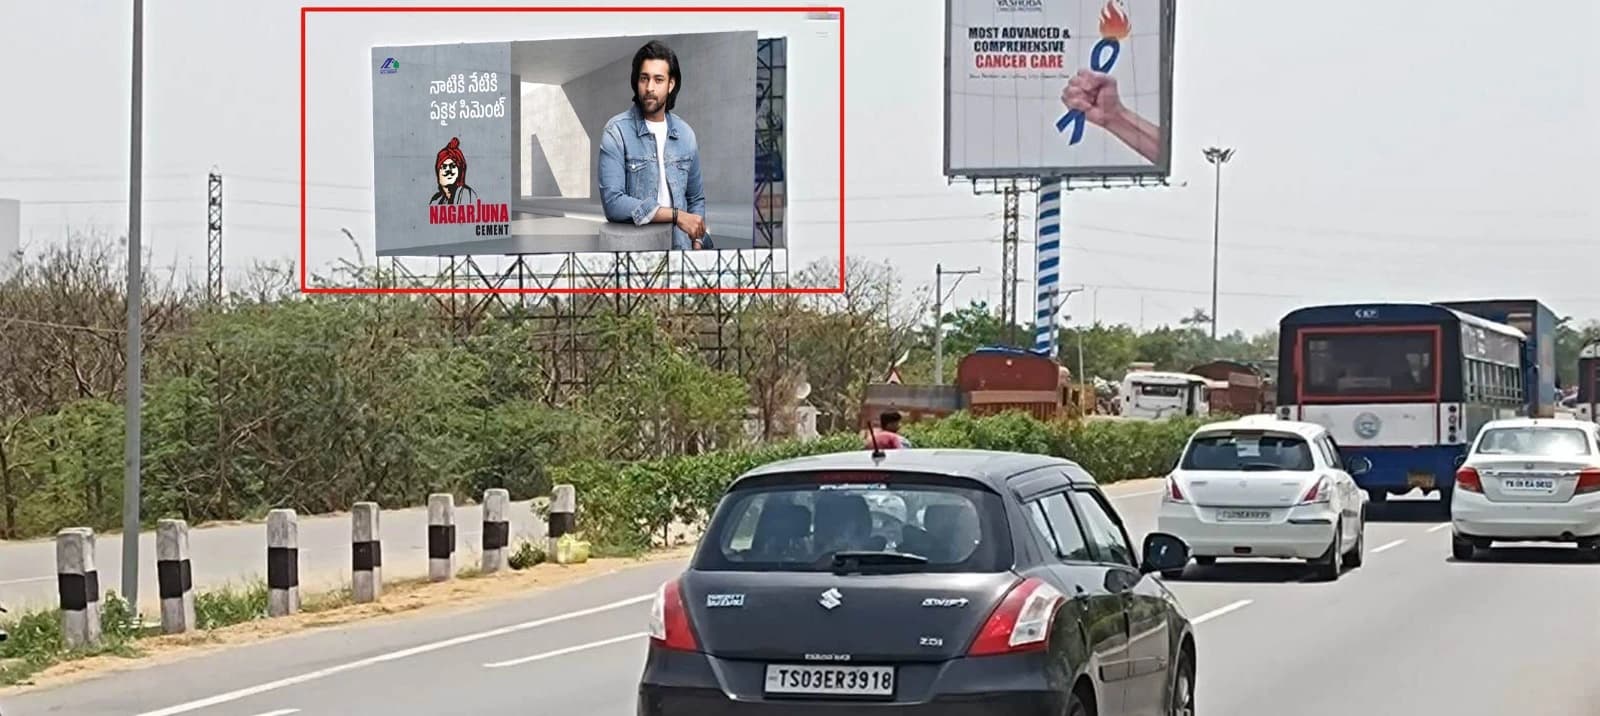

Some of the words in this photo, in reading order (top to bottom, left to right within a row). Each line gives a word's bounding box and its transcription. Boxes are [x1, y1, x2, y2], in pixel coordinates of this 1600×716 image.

[968, 27, 999, 39] MOST
[1001, 27, 1060, 39] ADVANCED
[1062, 28, 1071, 39] &
[973, 41, 1065, 53] COMPREHENSIVE
[975, 54, 1027, 69] CANCER
[1030, 54, 1064, 69] CARE
[429, 73, 465, 95] నాటికి
[468, 71, 498, 93] నేటికి
[430, 100, 457, 126] ఏకైక
[459, 96, 507, 119] సిమెంట్
[429, 198, 509, 224] NAGARJUNA
[475, 224, 510, 236] CEMENT
[779, 669, 892, 690] TS03ER3918
